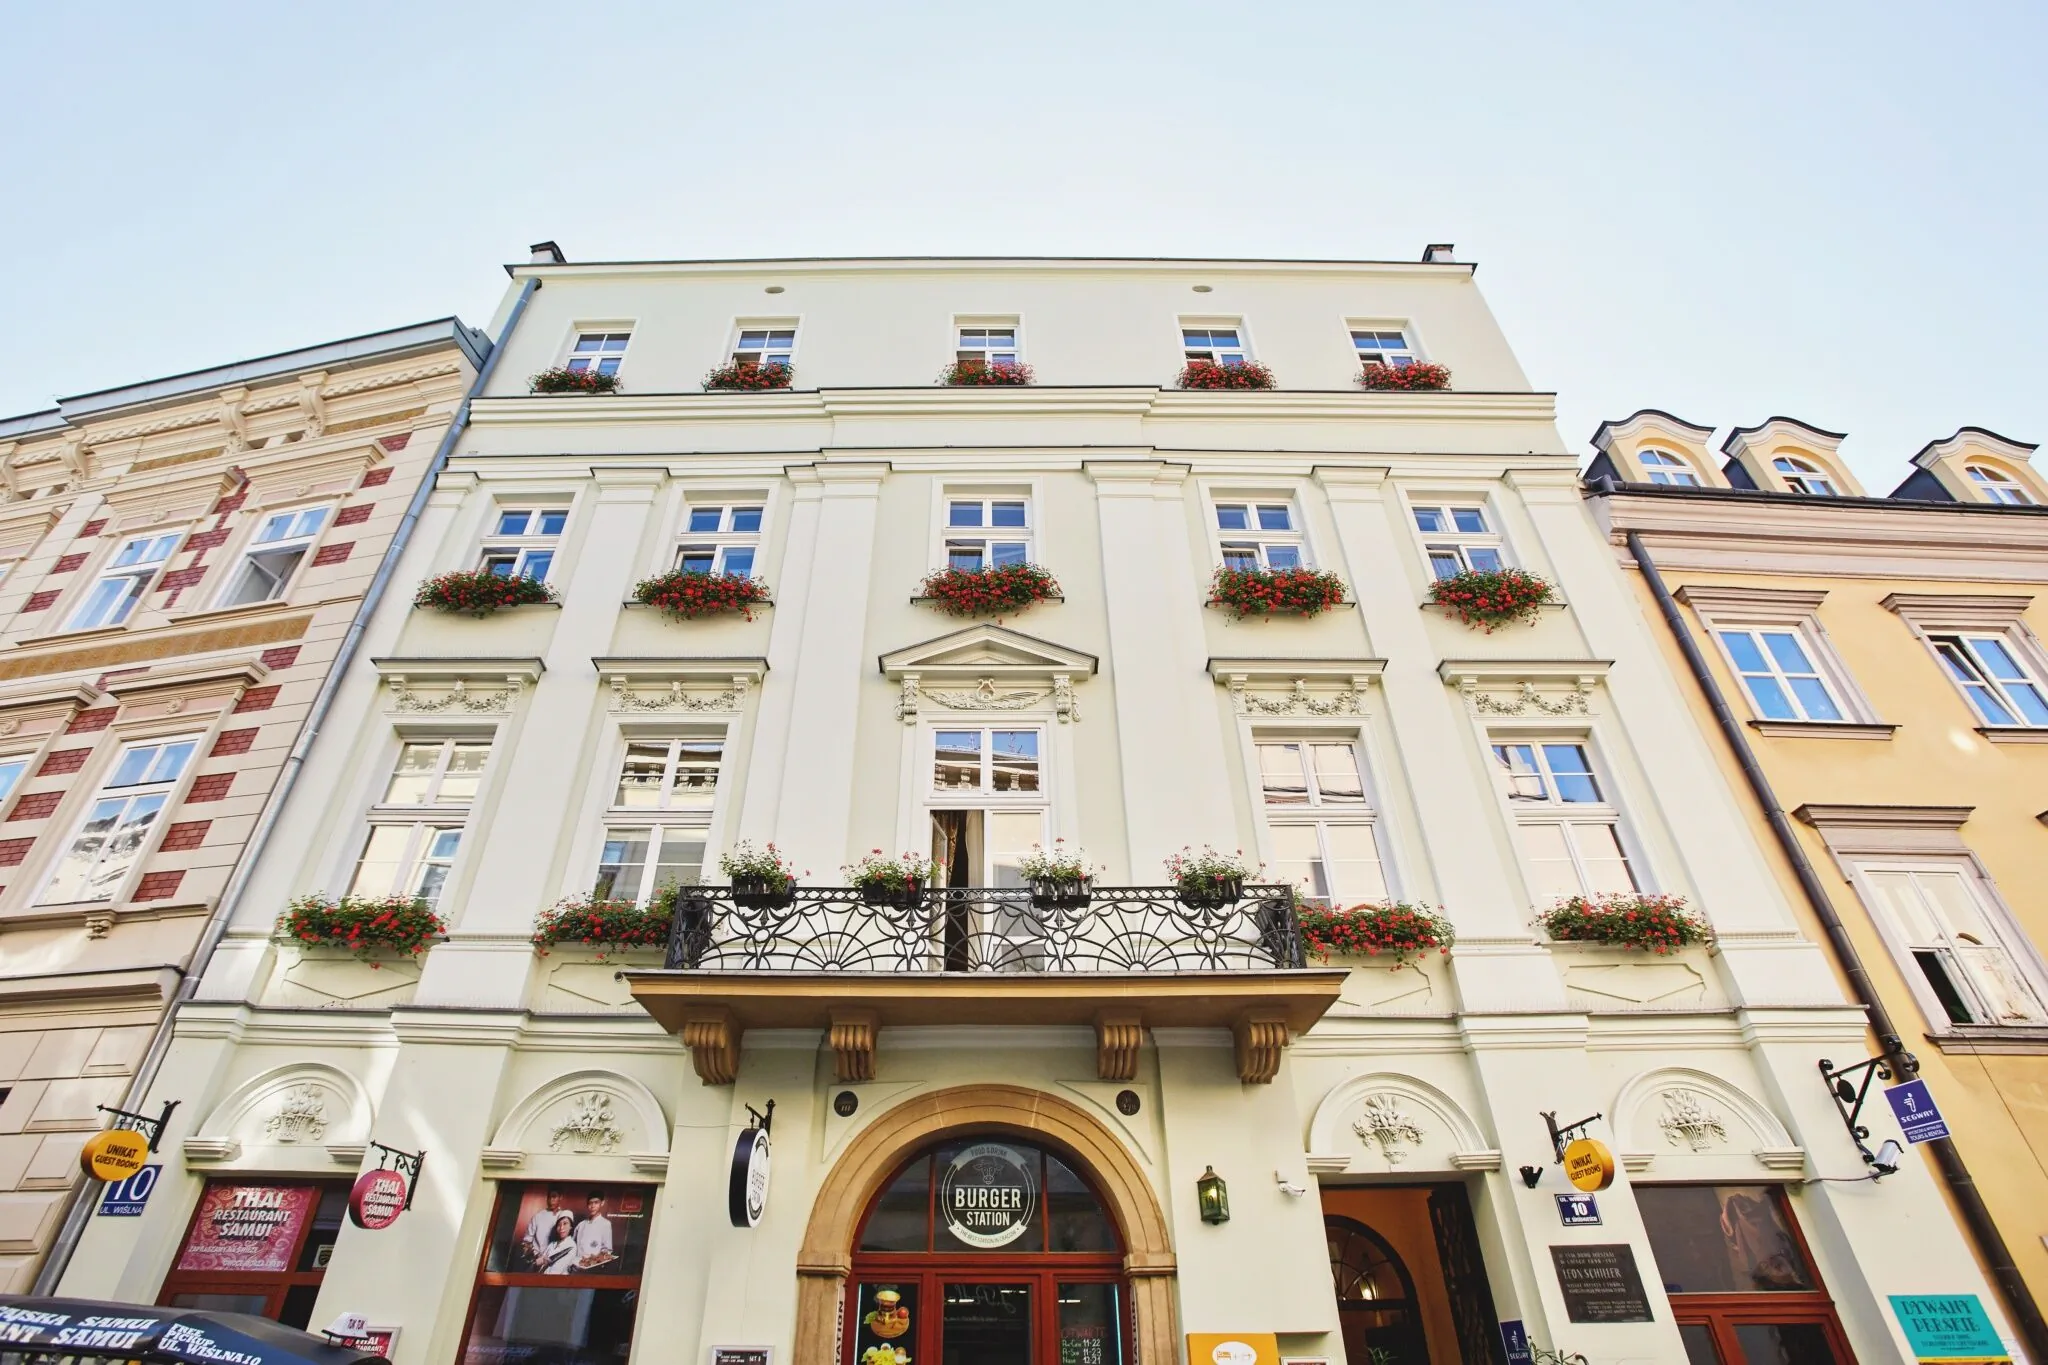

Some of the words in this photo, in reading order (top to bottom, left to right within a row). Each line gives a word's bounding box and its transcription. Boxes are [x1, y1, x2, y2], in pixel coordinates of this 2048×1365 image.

[1900, 1109, 1934, 1123] SEGWAY
[106, 1144, 138, 1159] UNIKAT
[94, 1155, 117, 1167] GUEST
[116, 1159, 140, 1170] ROOMS
[1571, 1154, 1593, 1170] UNIKAT
[1570, 1171, 1584, 1181] GUEST
[1584, 1163, 1601, 1177] ROOMS
[114, 1167, 156, 1200] 10
[374, 1179, 401, 1194] THAI
[233, 1191, 285, 1209] THAI
[364, 1193, 403, 1205] RESTAURANT
[955, 1187, 1022, 1209] BURGER
[113, 1204, 142, 1214] WIŚLNA
[213, 1210, 292, 1222] RESTAURANT
[366, 1205, 394, 1217] SAMUI
[1571, 1202, 1588, 1216] 10
[966, 1211, 1011, 1226] STATION
[220, 1223, 274, 1237] SAMUI
[1562, 1268, 1583, 1280] LEON
[78, 1316, 159, 1330] SAMUI
[170, 1323, 205, 1337] FREE
[50, 1328, 144, 1350] SAMUI
[186, 1343, 244, 1363] WIŚLNA
